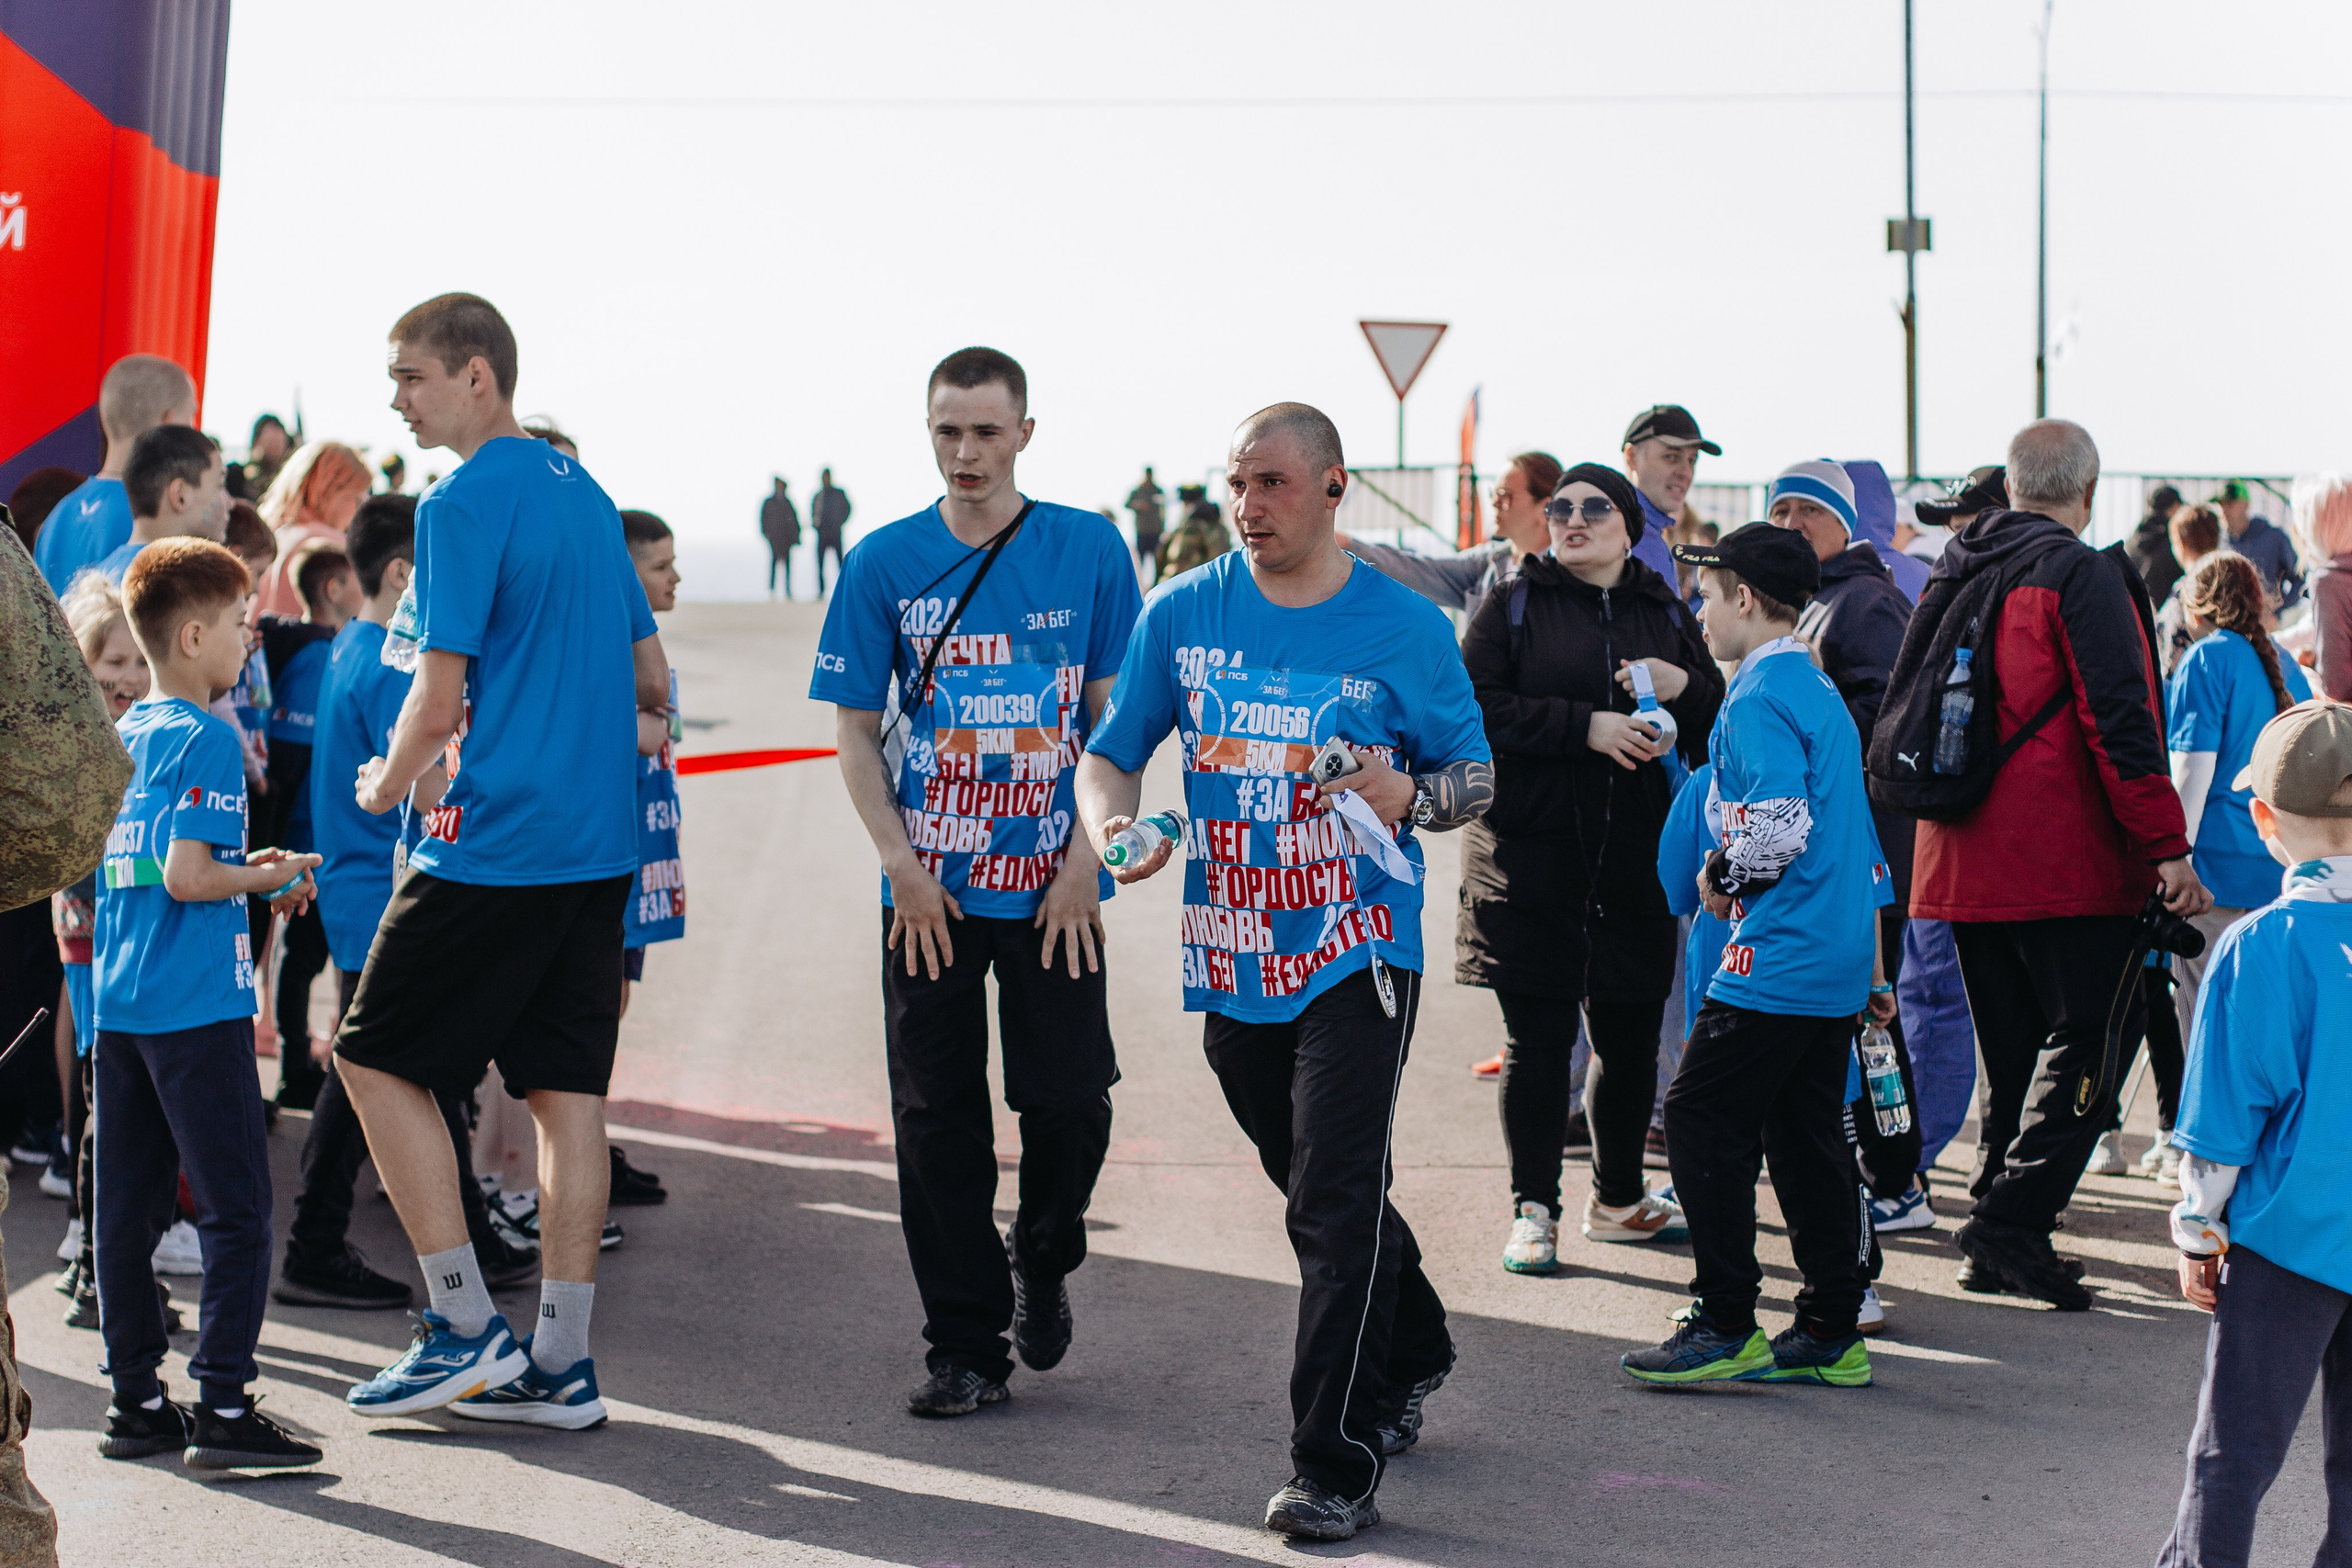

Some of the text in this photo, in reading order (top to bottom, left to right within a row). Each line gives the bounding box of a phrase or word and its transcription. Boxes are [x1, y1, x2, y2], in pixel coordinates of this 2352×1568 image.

[1682, 554, 1700, 562] FILA
[1227, 671, 1248, 681] ПСБ
[959, 694, 1035, 724] 20039
[1230, 700, 1310, 739] 20056
[1205, 858, 1357, 911] #ГОРДОСТЬ
